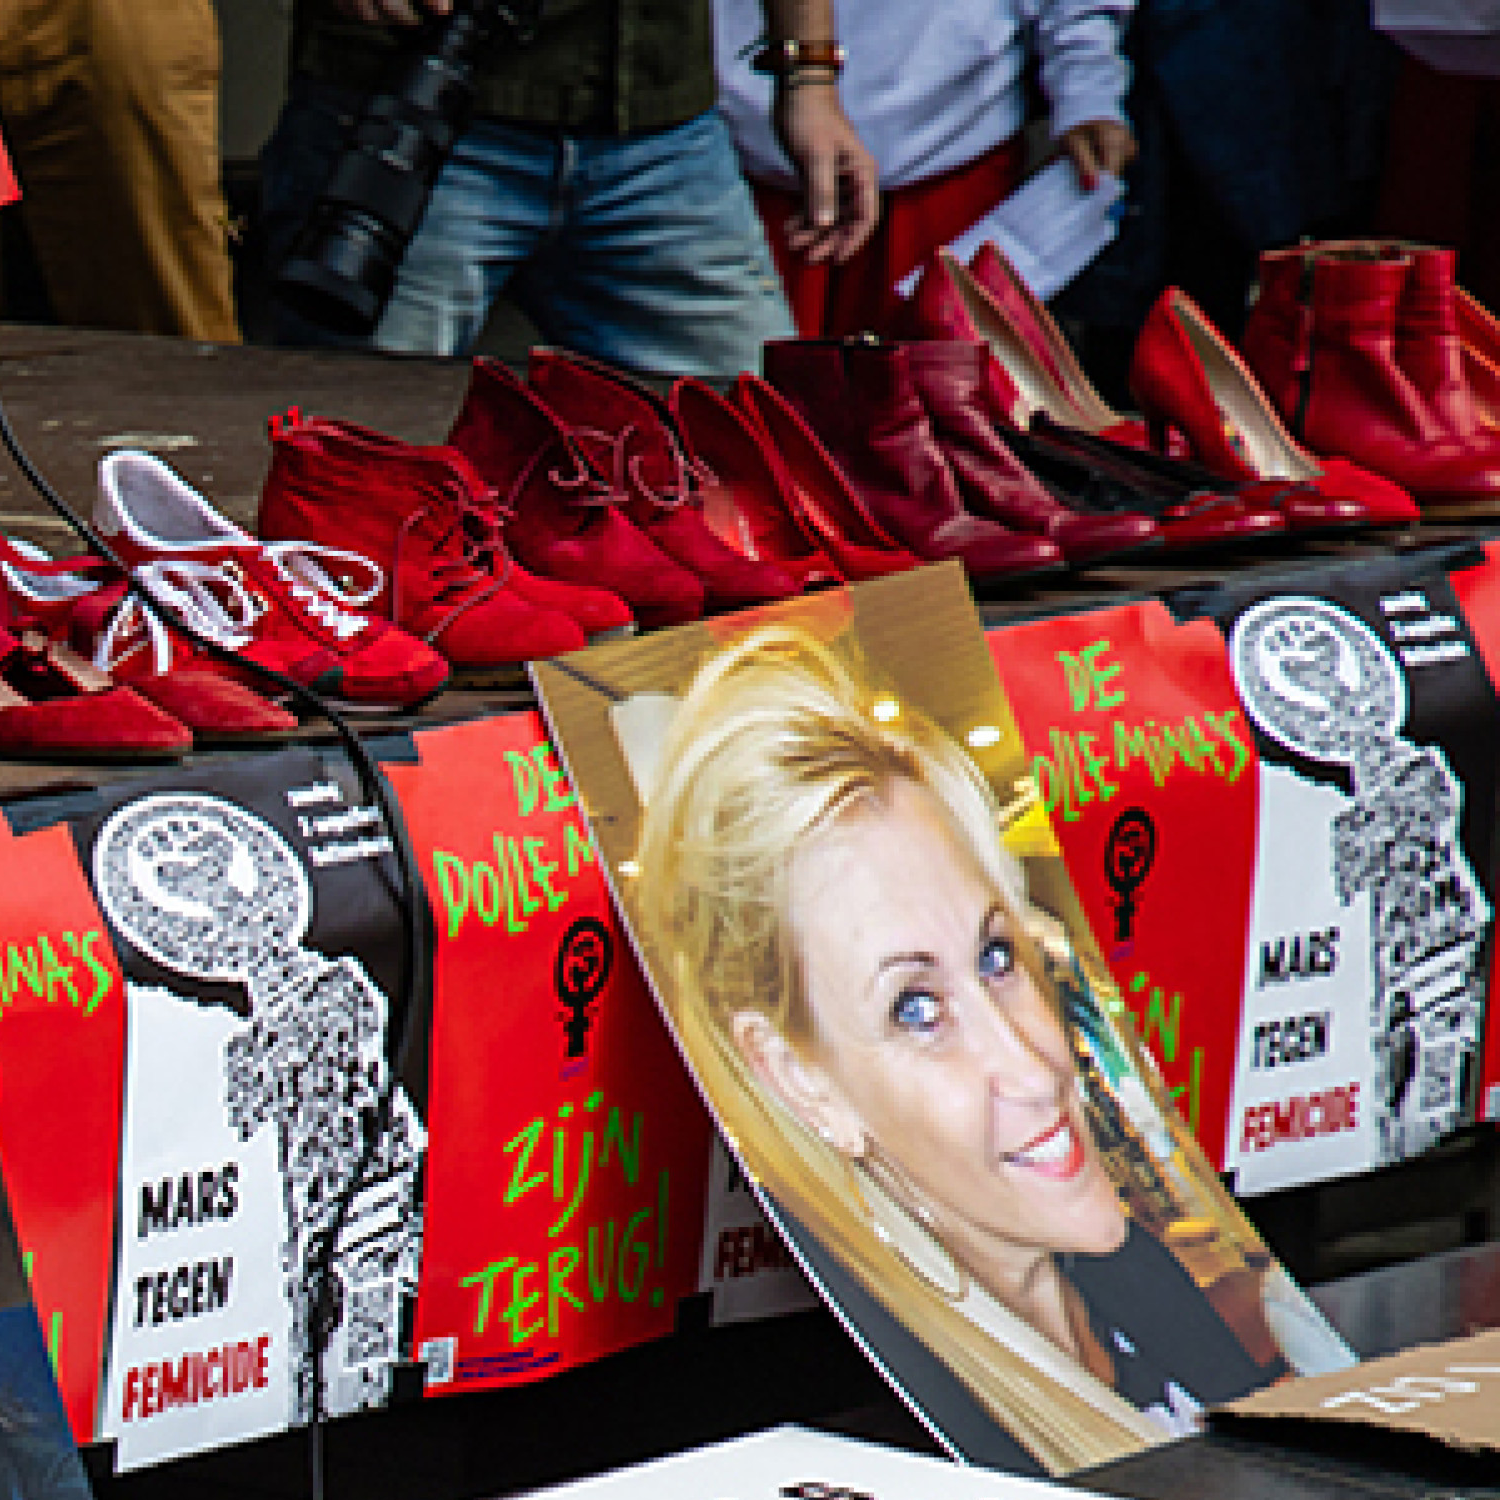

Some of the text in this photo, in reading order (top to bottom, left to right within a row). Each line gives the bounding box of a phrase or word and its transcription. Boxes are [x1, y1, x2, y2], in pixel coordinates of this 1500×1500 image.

[1057, 640, 1126, 712] DE
[503, 740, 578, 818] DE
[1033, 729, 1120, 829] OLLE
[432, 832, 567, 938] DOLLE
[1259, 927, 1339, 989] MARS
[1253, 1011, 1333, 1070] TEGEN
[1238, 1080, 1362, 1153] FEMICIDE
[137, 1162, 240, 1237] MARS
[132, 1255, 235, 1328] TEGEN
[460, 1162, 670, 1346] TERUG!
[122, 1336, 271, 1422] FEMICIDE
